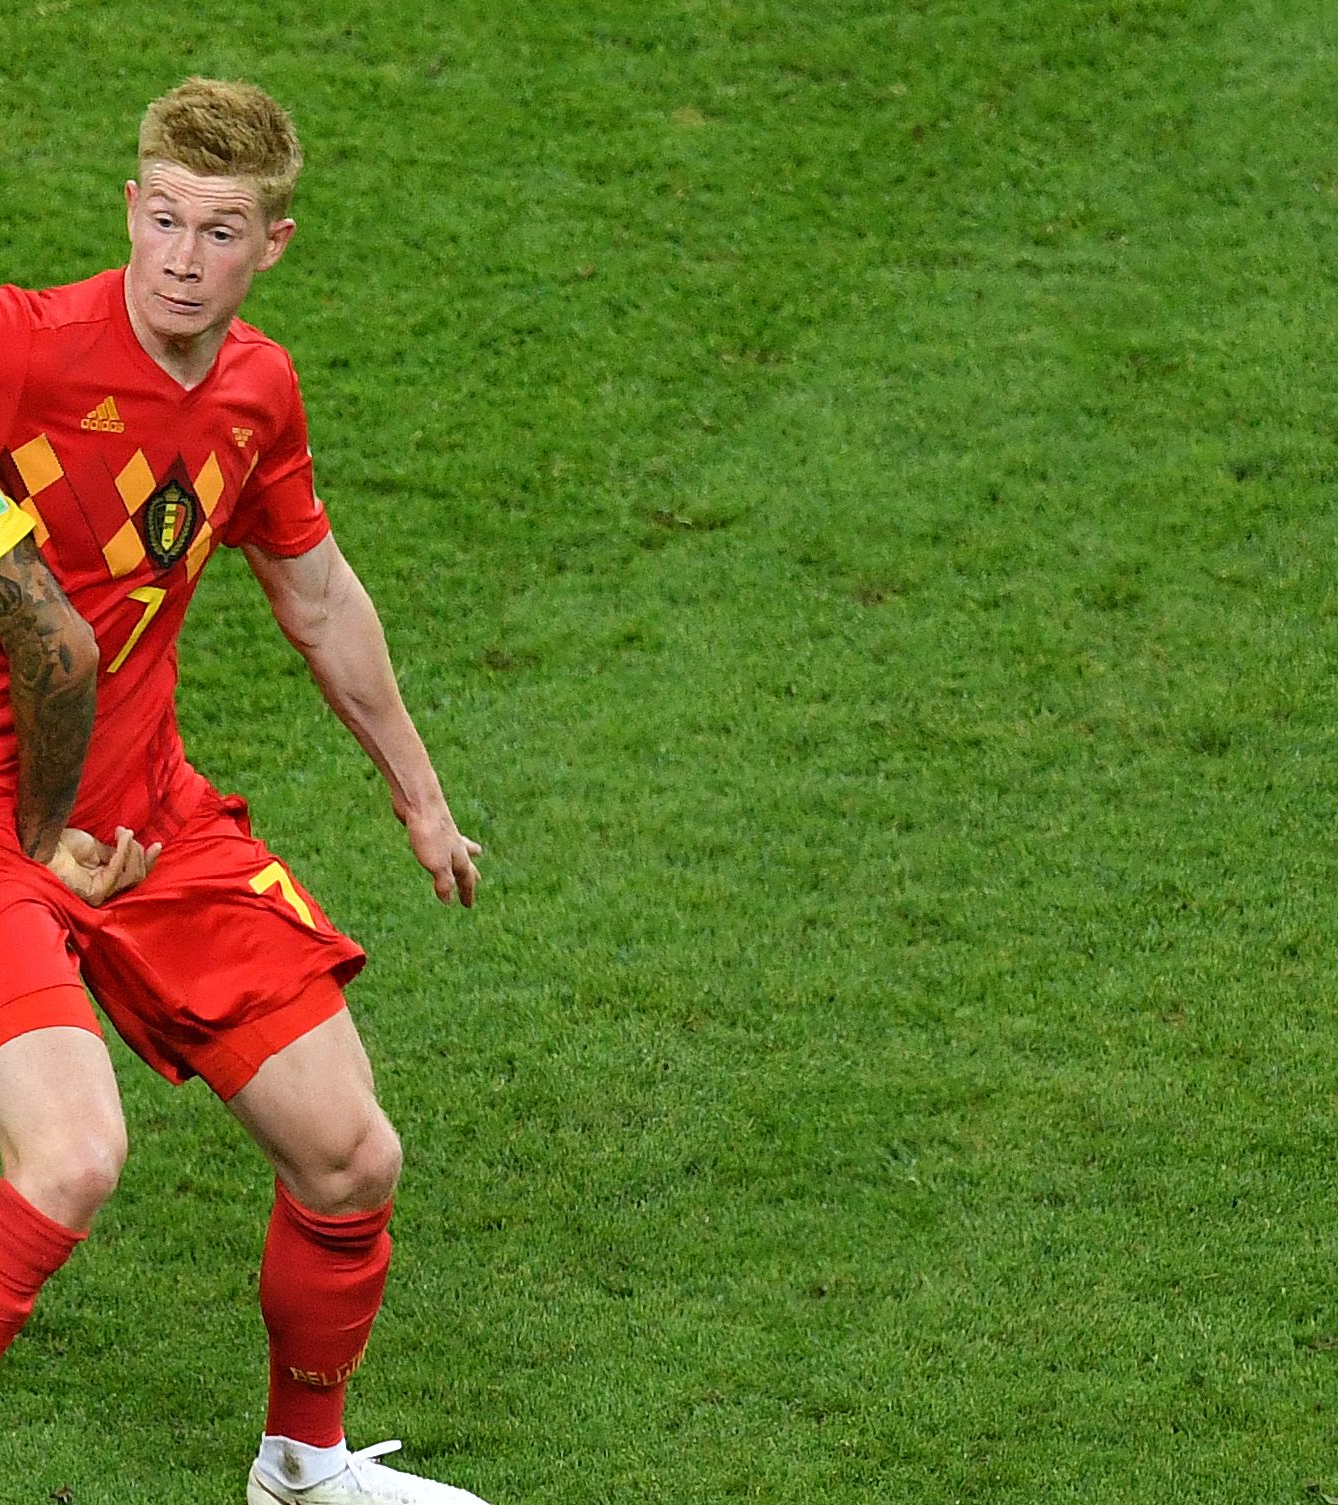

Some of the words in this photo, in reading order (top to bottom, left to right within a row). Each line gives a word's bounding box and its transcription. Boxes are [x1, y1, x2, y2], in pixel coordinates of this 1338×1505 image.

[80, 418, 125, 434] adidas
[106, 587, 166, 673] 7
[248, 861, 316, 930] 7
